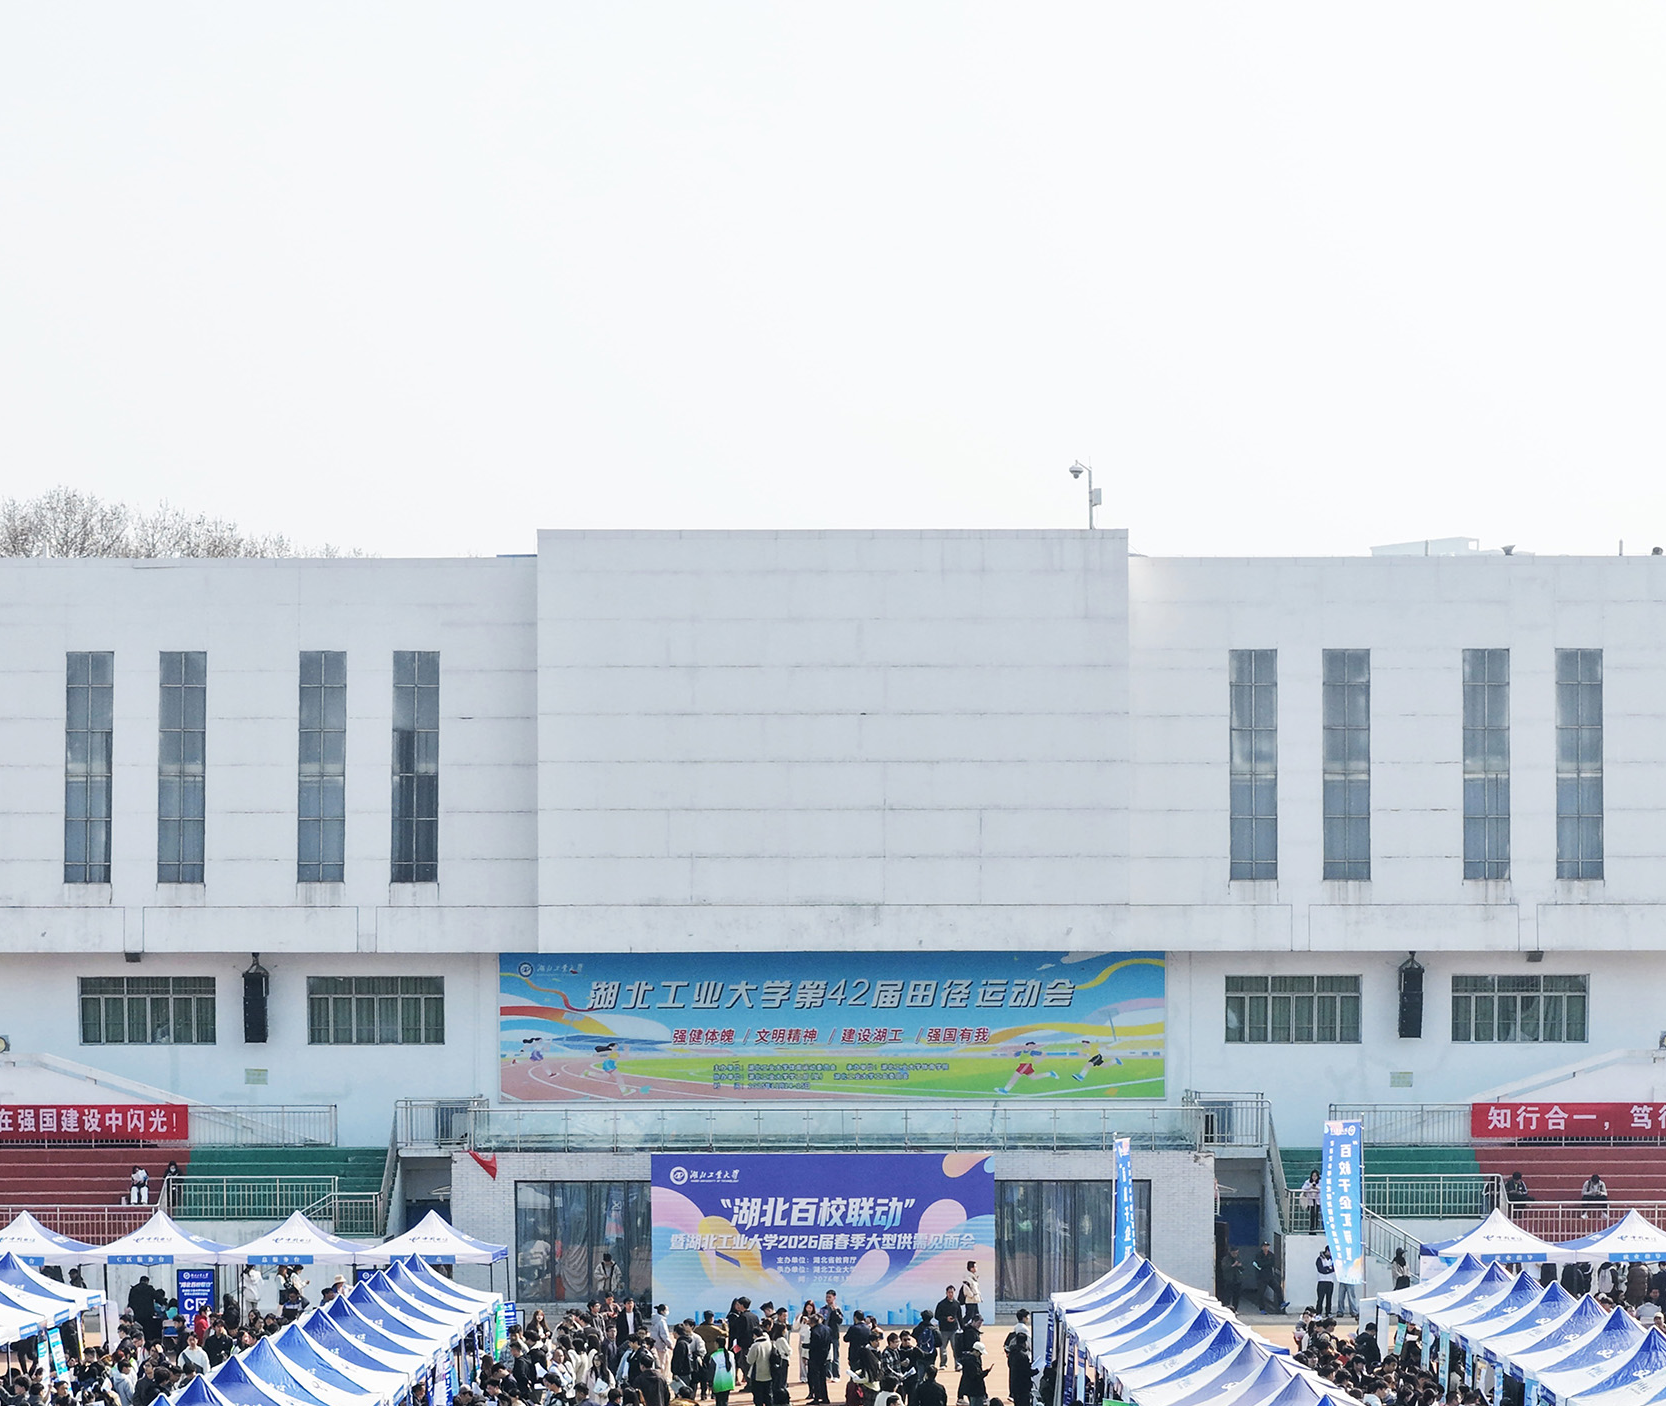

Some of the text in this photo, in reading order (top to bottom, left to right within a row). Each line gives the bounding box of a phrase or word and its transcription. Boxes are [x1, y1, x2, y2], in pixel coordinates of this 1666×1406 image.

[587, 978, 1075, 1010] 湖北工业大学第42届田径运动会
[672, 1027, 990, 1045] 强健体魄 文明精神 建设湖工 强国有我
[720, 1196, 916, 1230] “湖北百校联动”
[669, 1233, 976, 1252] 暨湖北工业大学2026届春季大型供需见面会
[813, 1256, 857, 1265] 湖北省教育厅
